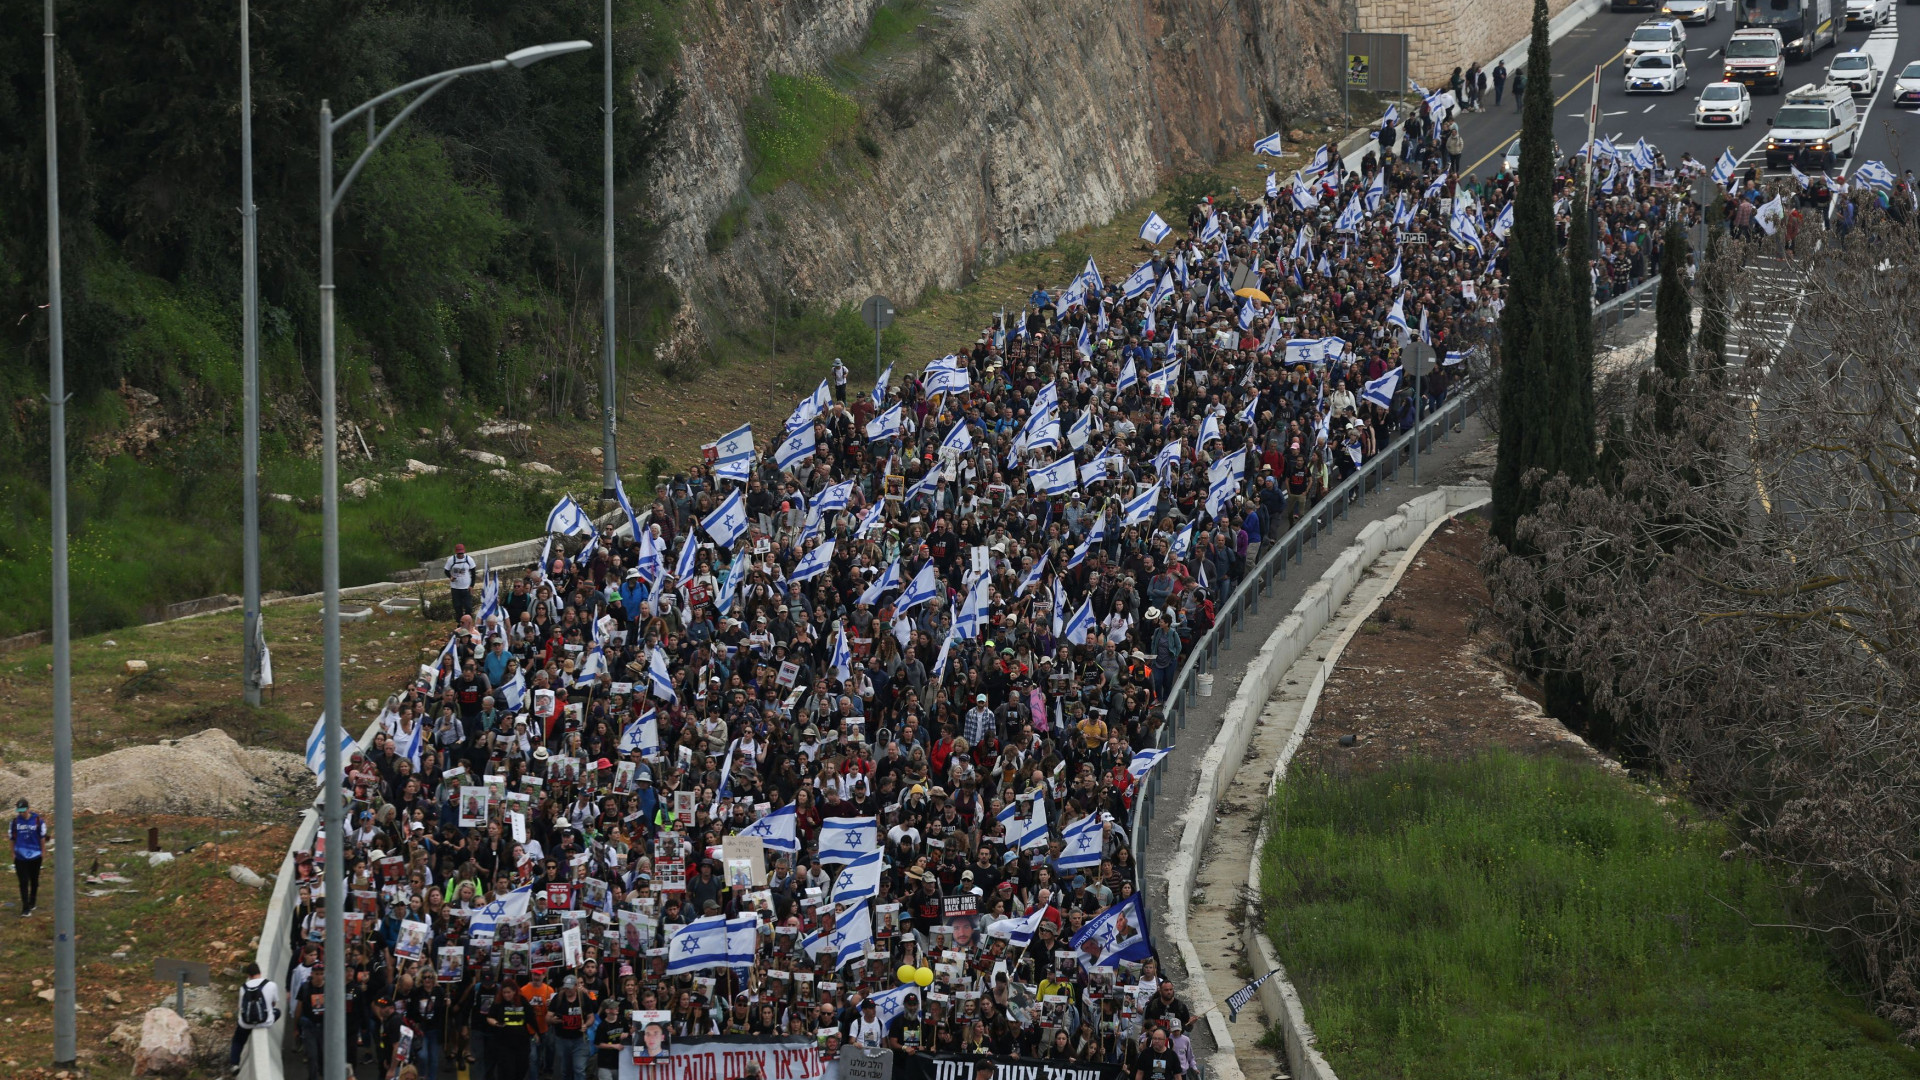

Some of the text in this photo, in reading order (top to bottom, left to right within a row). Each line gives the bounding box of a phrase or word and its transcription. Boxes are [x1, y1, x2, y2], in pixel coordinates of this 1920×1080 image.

[945, 904, 960, 912] BACK
[961, 903, 977, 911] HOME
[1229, 985, 1255, 1009] BRING
